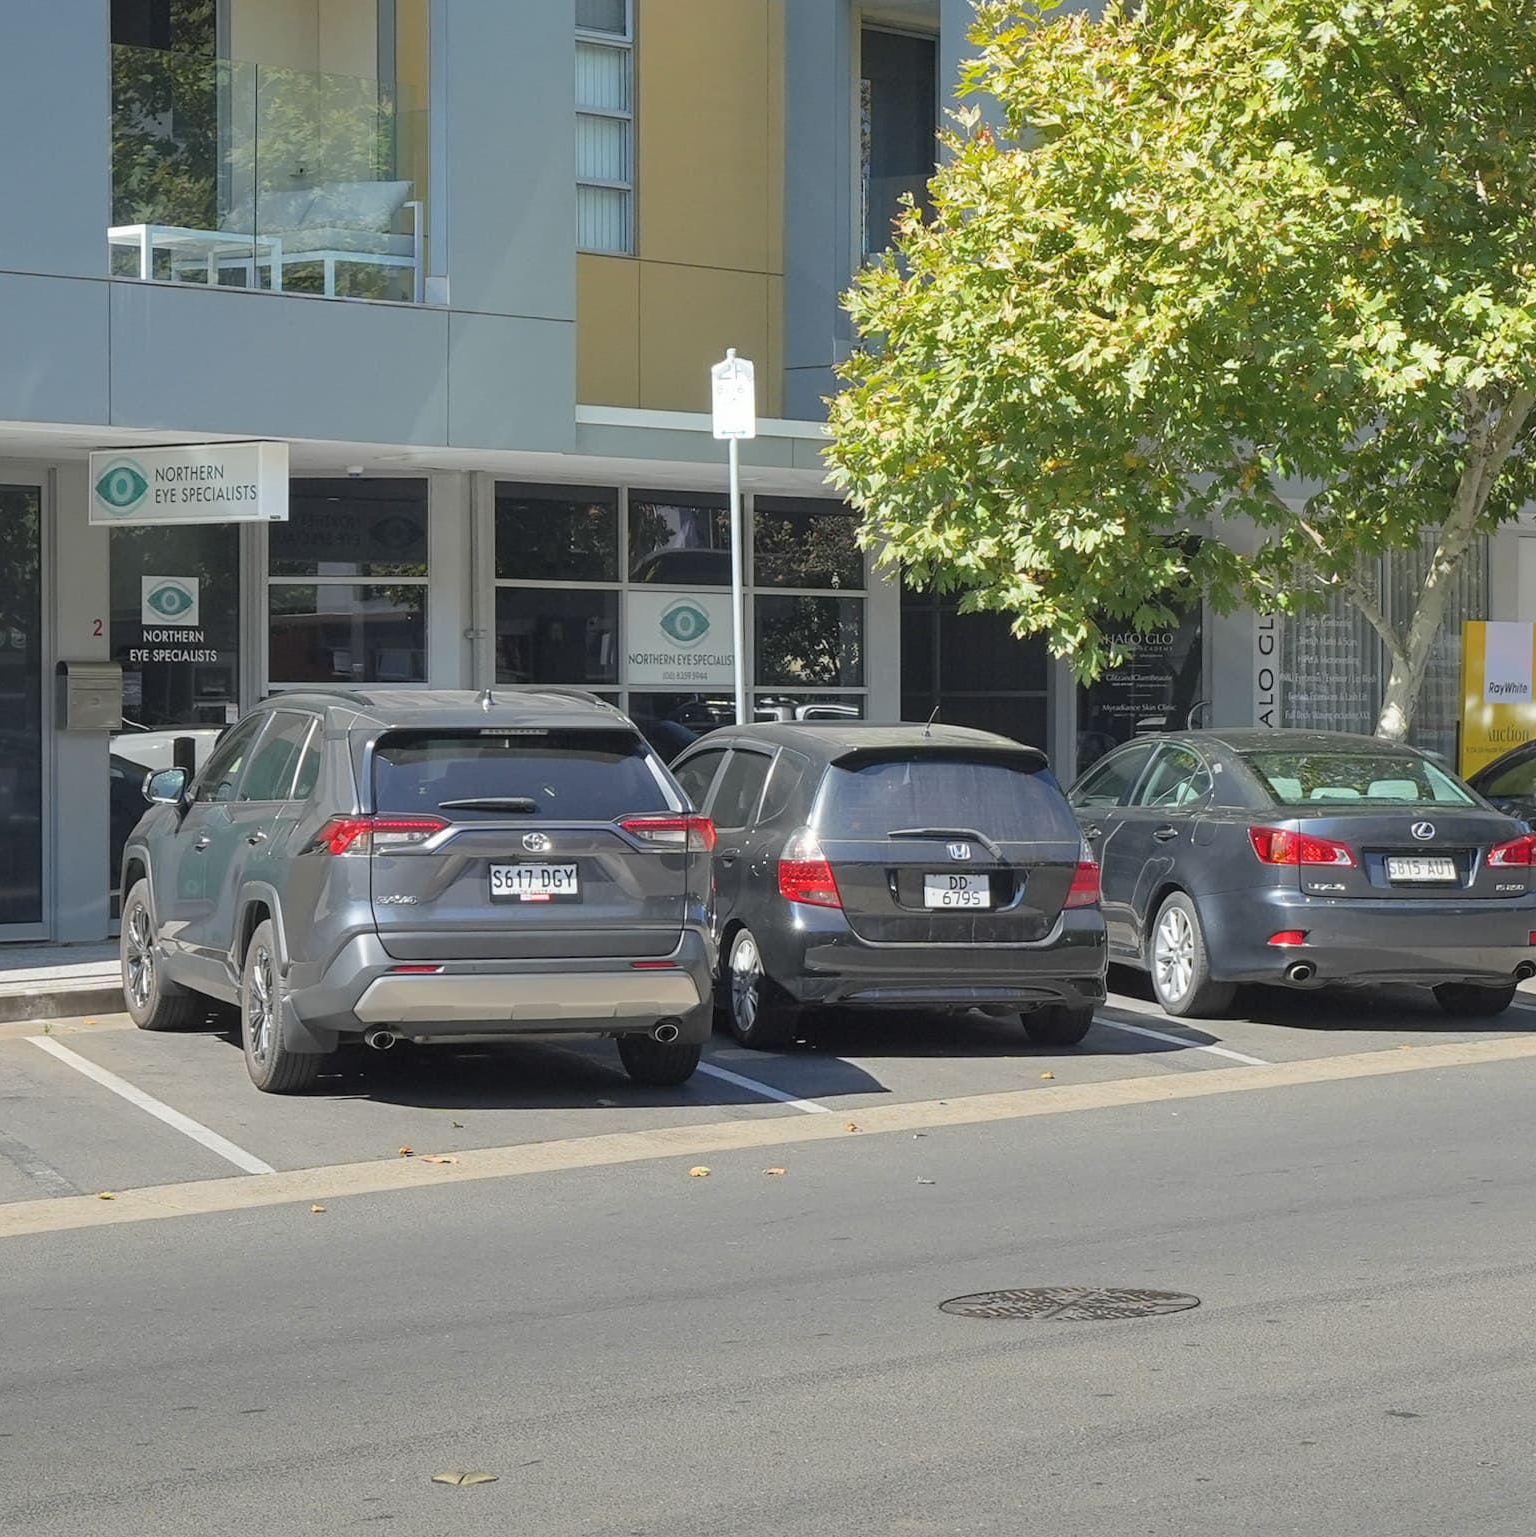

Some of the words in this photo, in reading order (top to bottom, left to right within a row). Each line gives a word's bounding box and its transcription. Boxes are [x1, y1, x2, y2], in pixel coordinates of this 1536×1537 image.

[154, 464, 225, 483] NORTHERN
[155, 487, 177, 504] EYE
[181, 484, 257, 503] SPECIALISTS
[92, 618, 104, 637] 2
[142, 630, 205, 643] NORTHERN
[1145, 632, 1174, 645] GLO
[129, 649, 150, 663] EYE
[152, 649, 218, 663] SPECIALISTS
[628, 653, 677, 665] NORTHERN
[677, 653, 692, 666] EYE
[693, 653, 736, 666] SPECIALIST
[1259, 668, 1275, 729] ALO
